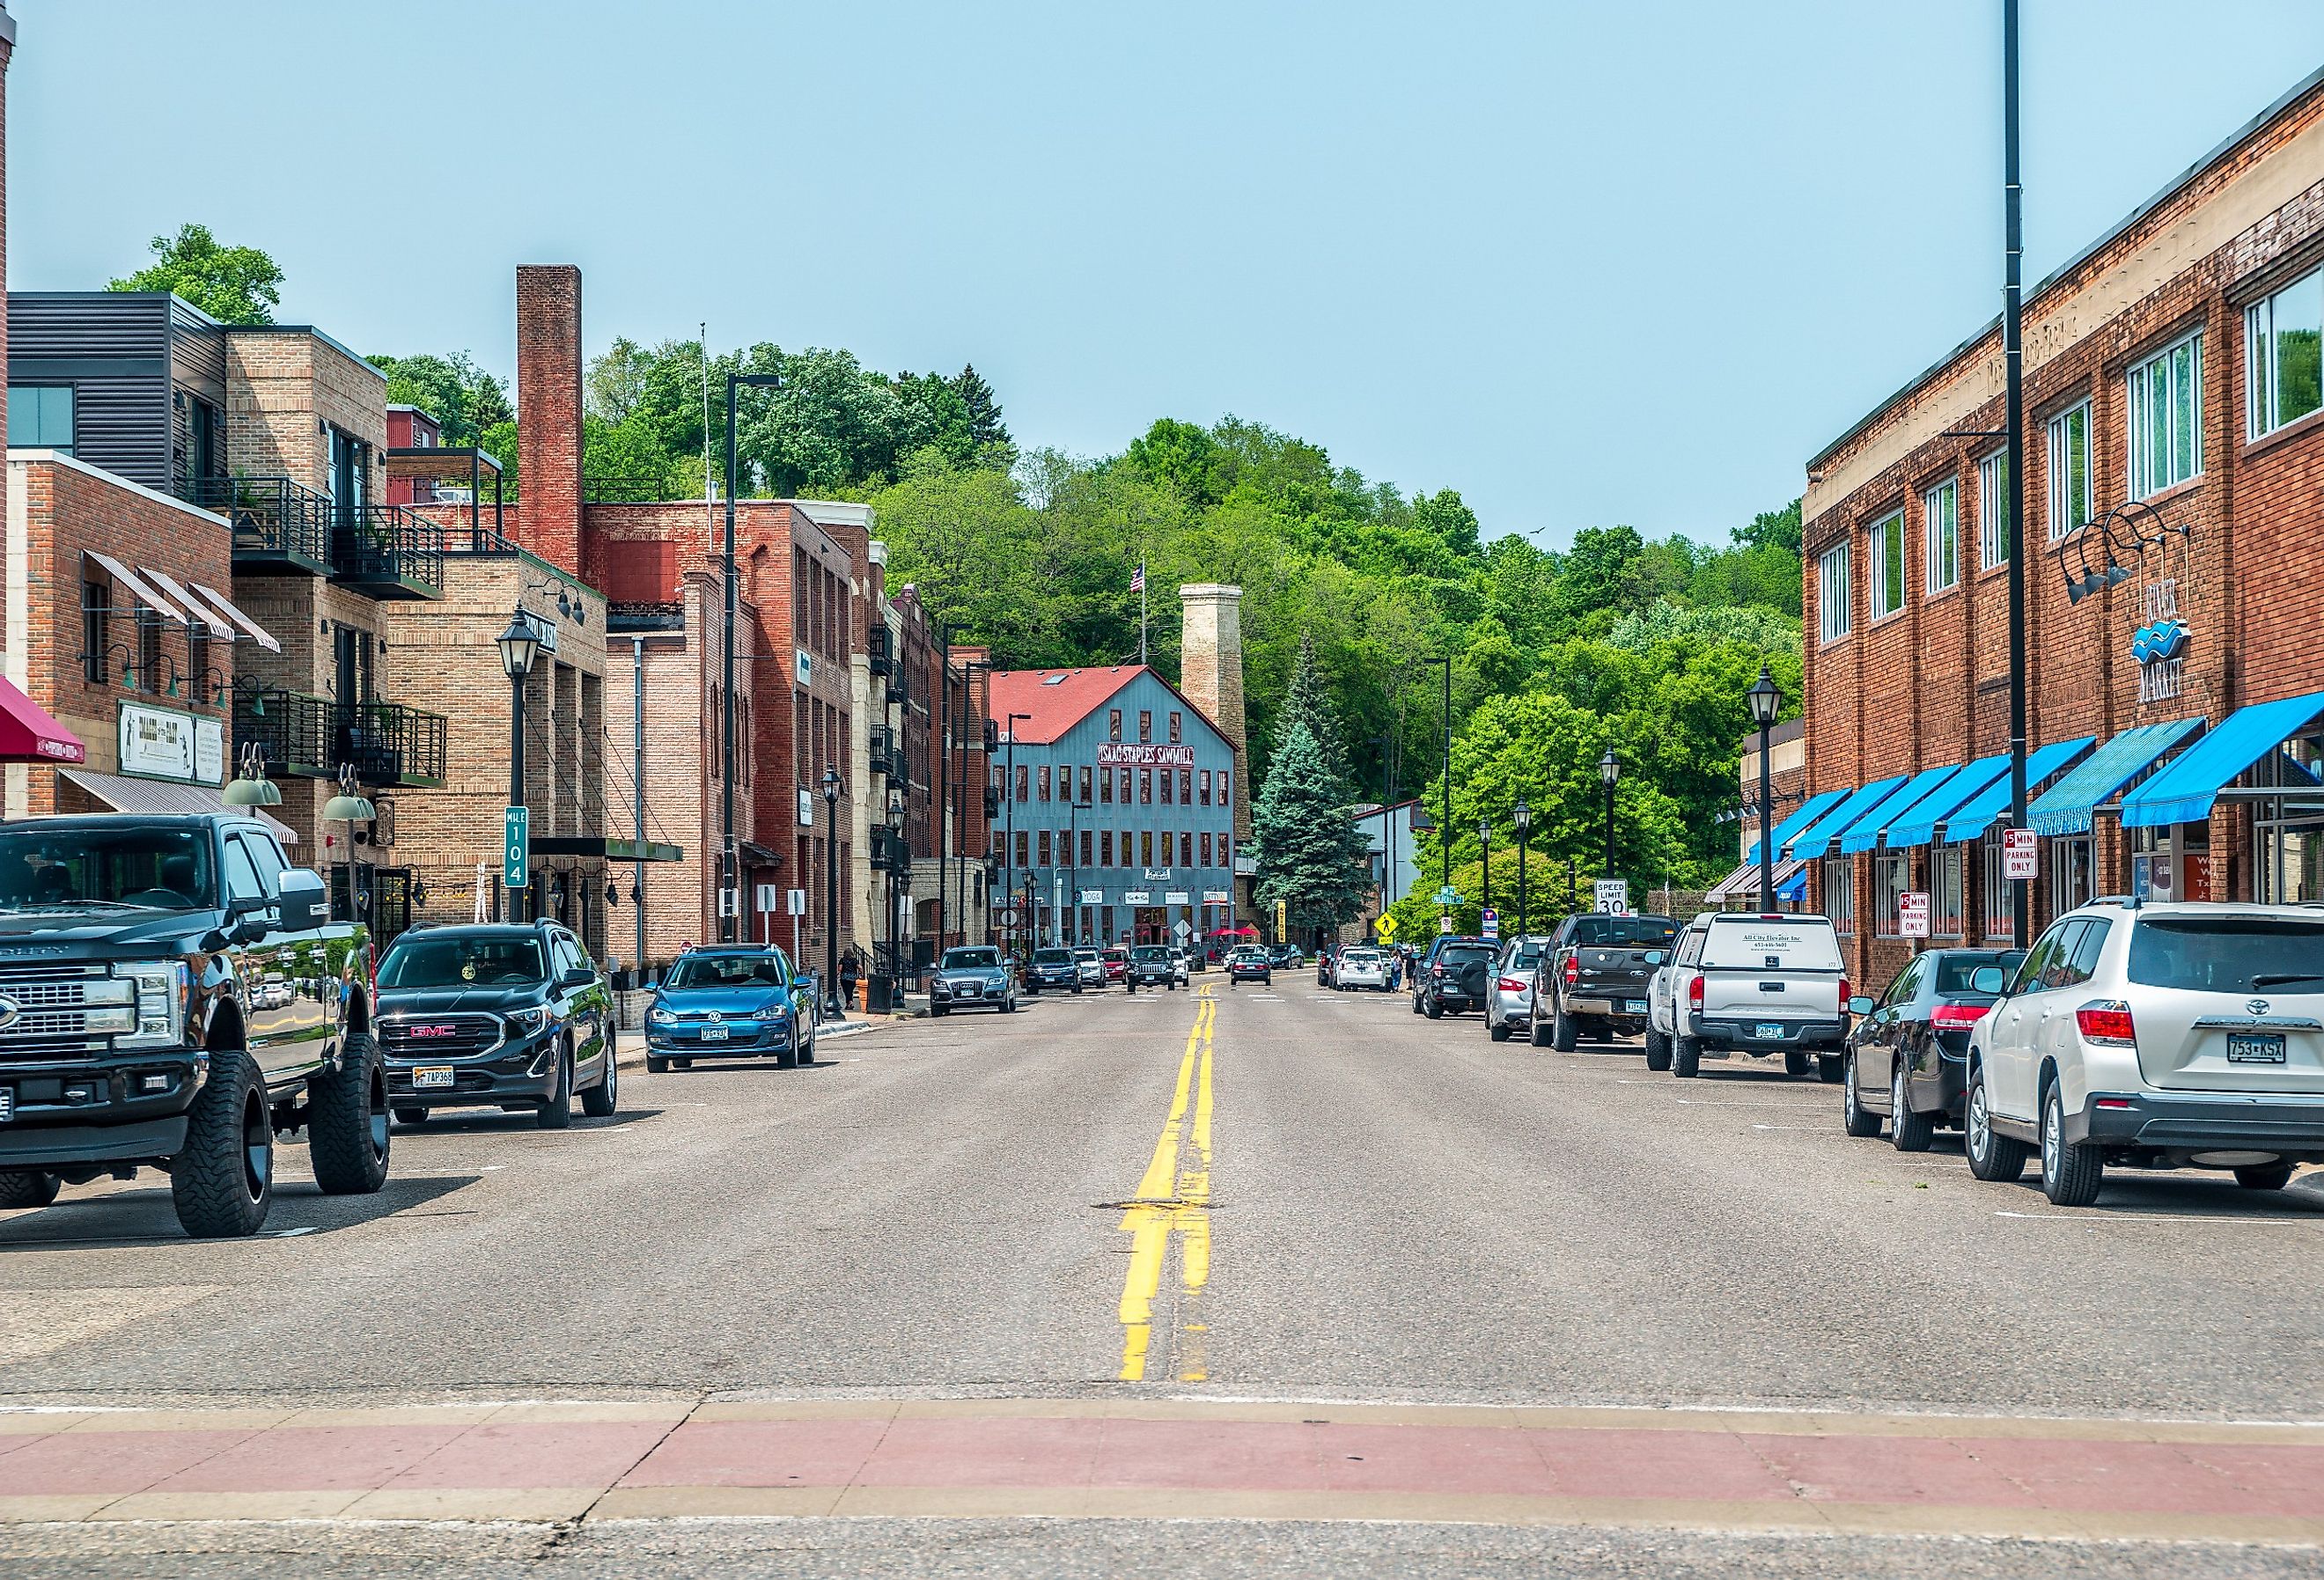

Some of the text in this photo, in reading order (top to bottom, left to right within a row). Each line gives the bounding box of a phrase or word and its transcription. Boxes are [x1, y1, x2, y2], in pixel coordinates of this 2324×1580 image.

[2146, 577, 2177, 622] RIVER
[2136, 658, 2183, 703] MARKET
[1100, 746, 1193, 765] ISAAC STAPLES SAWMILL
[507, 812, 526, 823] MILE
[2005, 834, 2033, 844] 15 MIN
[2006, 851, 2034, 860] PARKING
[2011, 862, 2031, 871] ONLY
[1599, 900, 1624, 914] 30
[1901, 897, 1926, 907] 15 MIN
[409, 1025, 456, 1038] GMC
[426, 1071, 452, 1082] 7AP368
